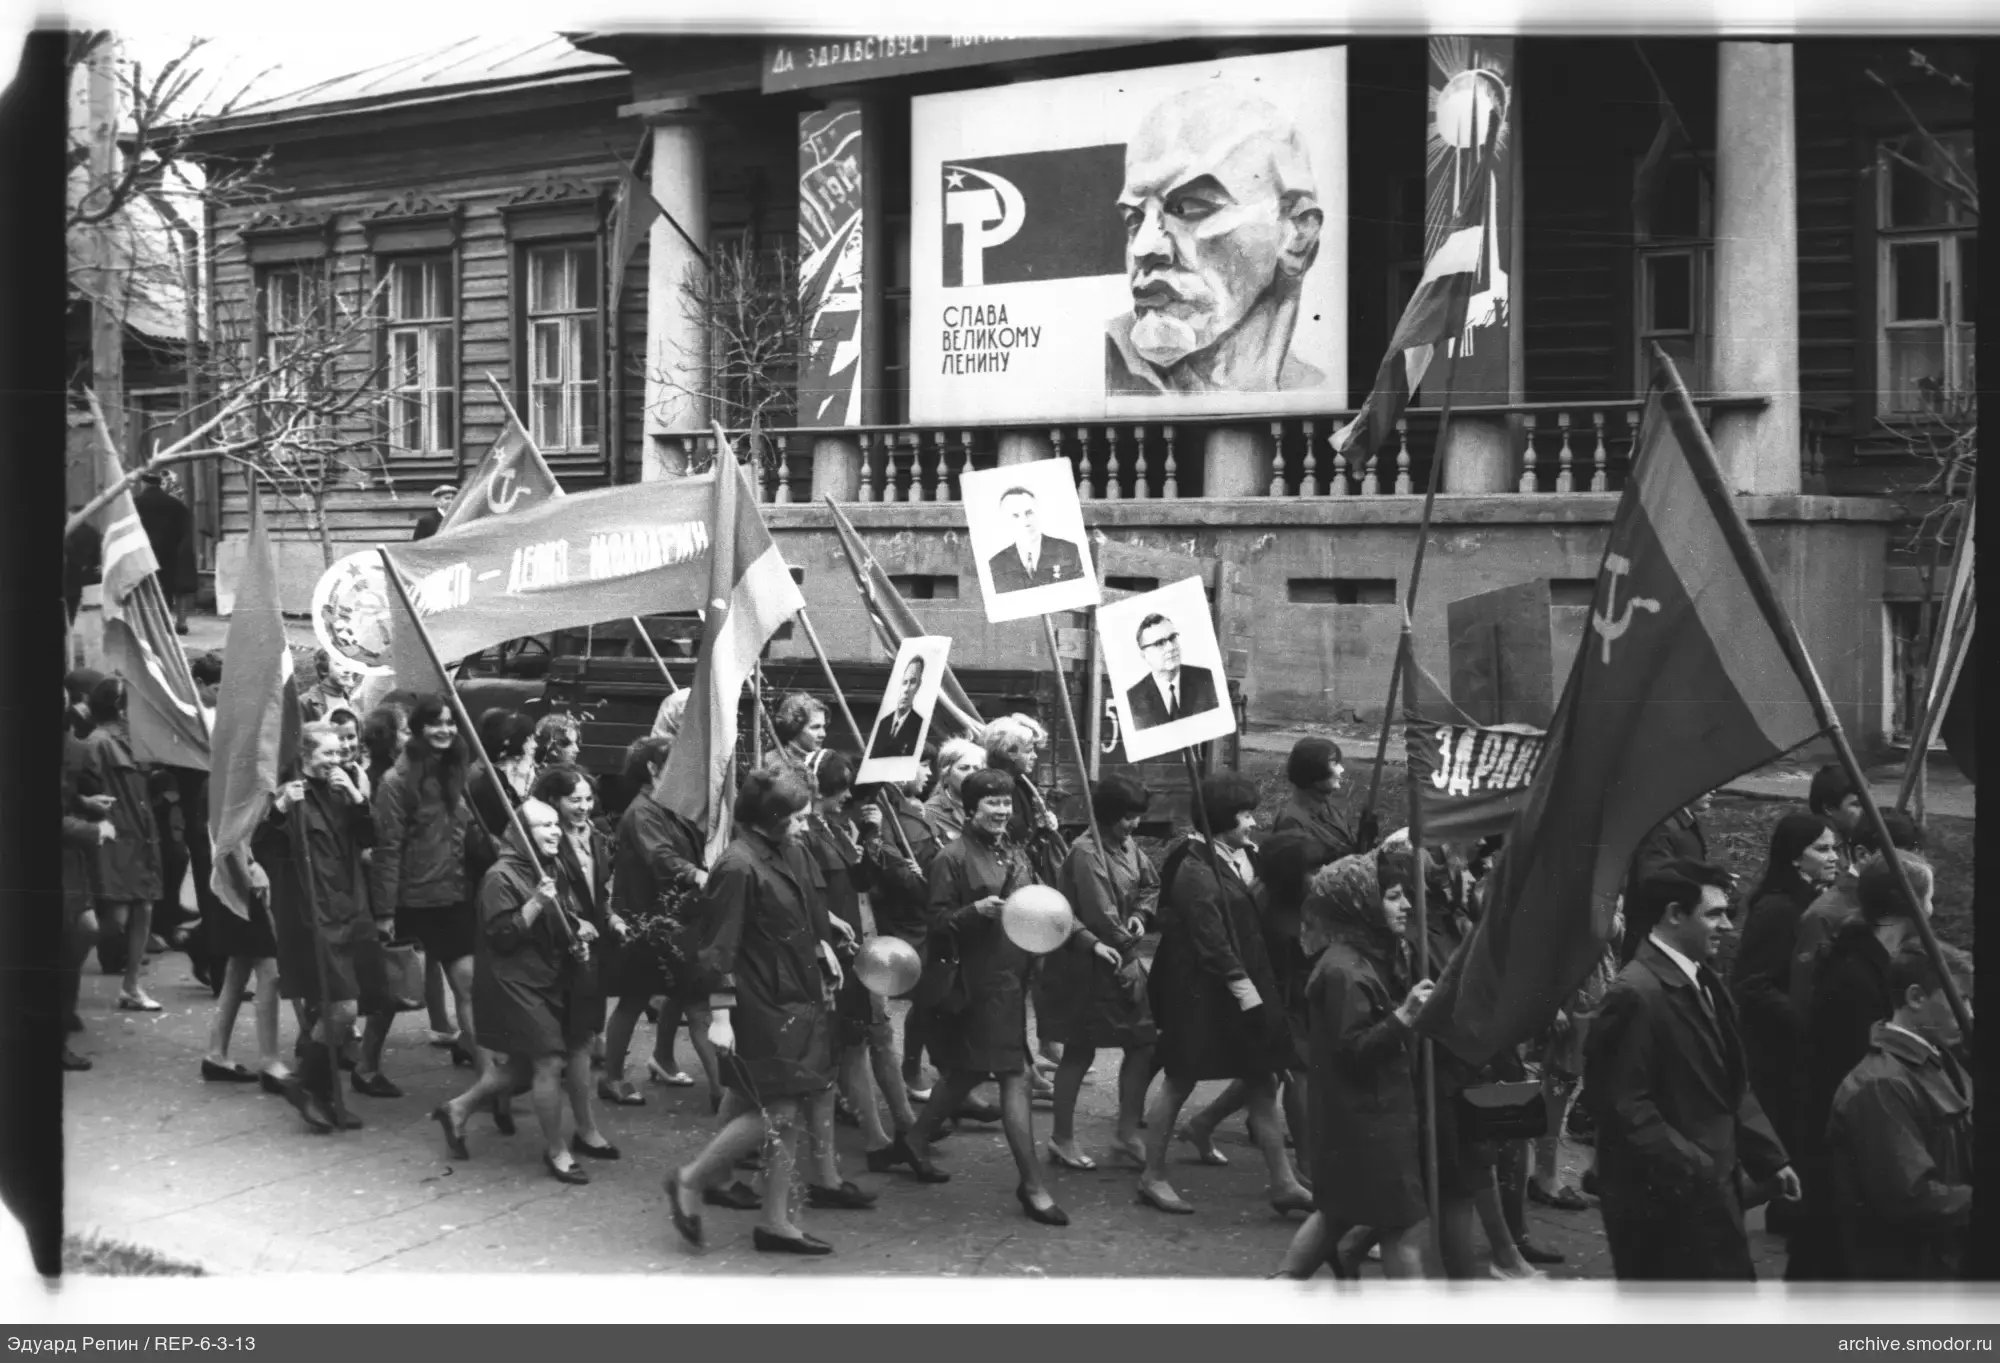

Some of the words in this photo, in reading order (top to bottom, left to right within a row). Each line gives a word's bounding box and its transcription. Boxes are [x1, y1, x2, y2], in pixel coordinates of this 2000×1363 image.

[772, 49, 794, 73] ДА
[943, 303, 1009, 328] СЛАВА
[942, 326, 1041, 351] ВЕЛИКОМУ
[942, 351, 1010, 375] ЛЕНИНУ
